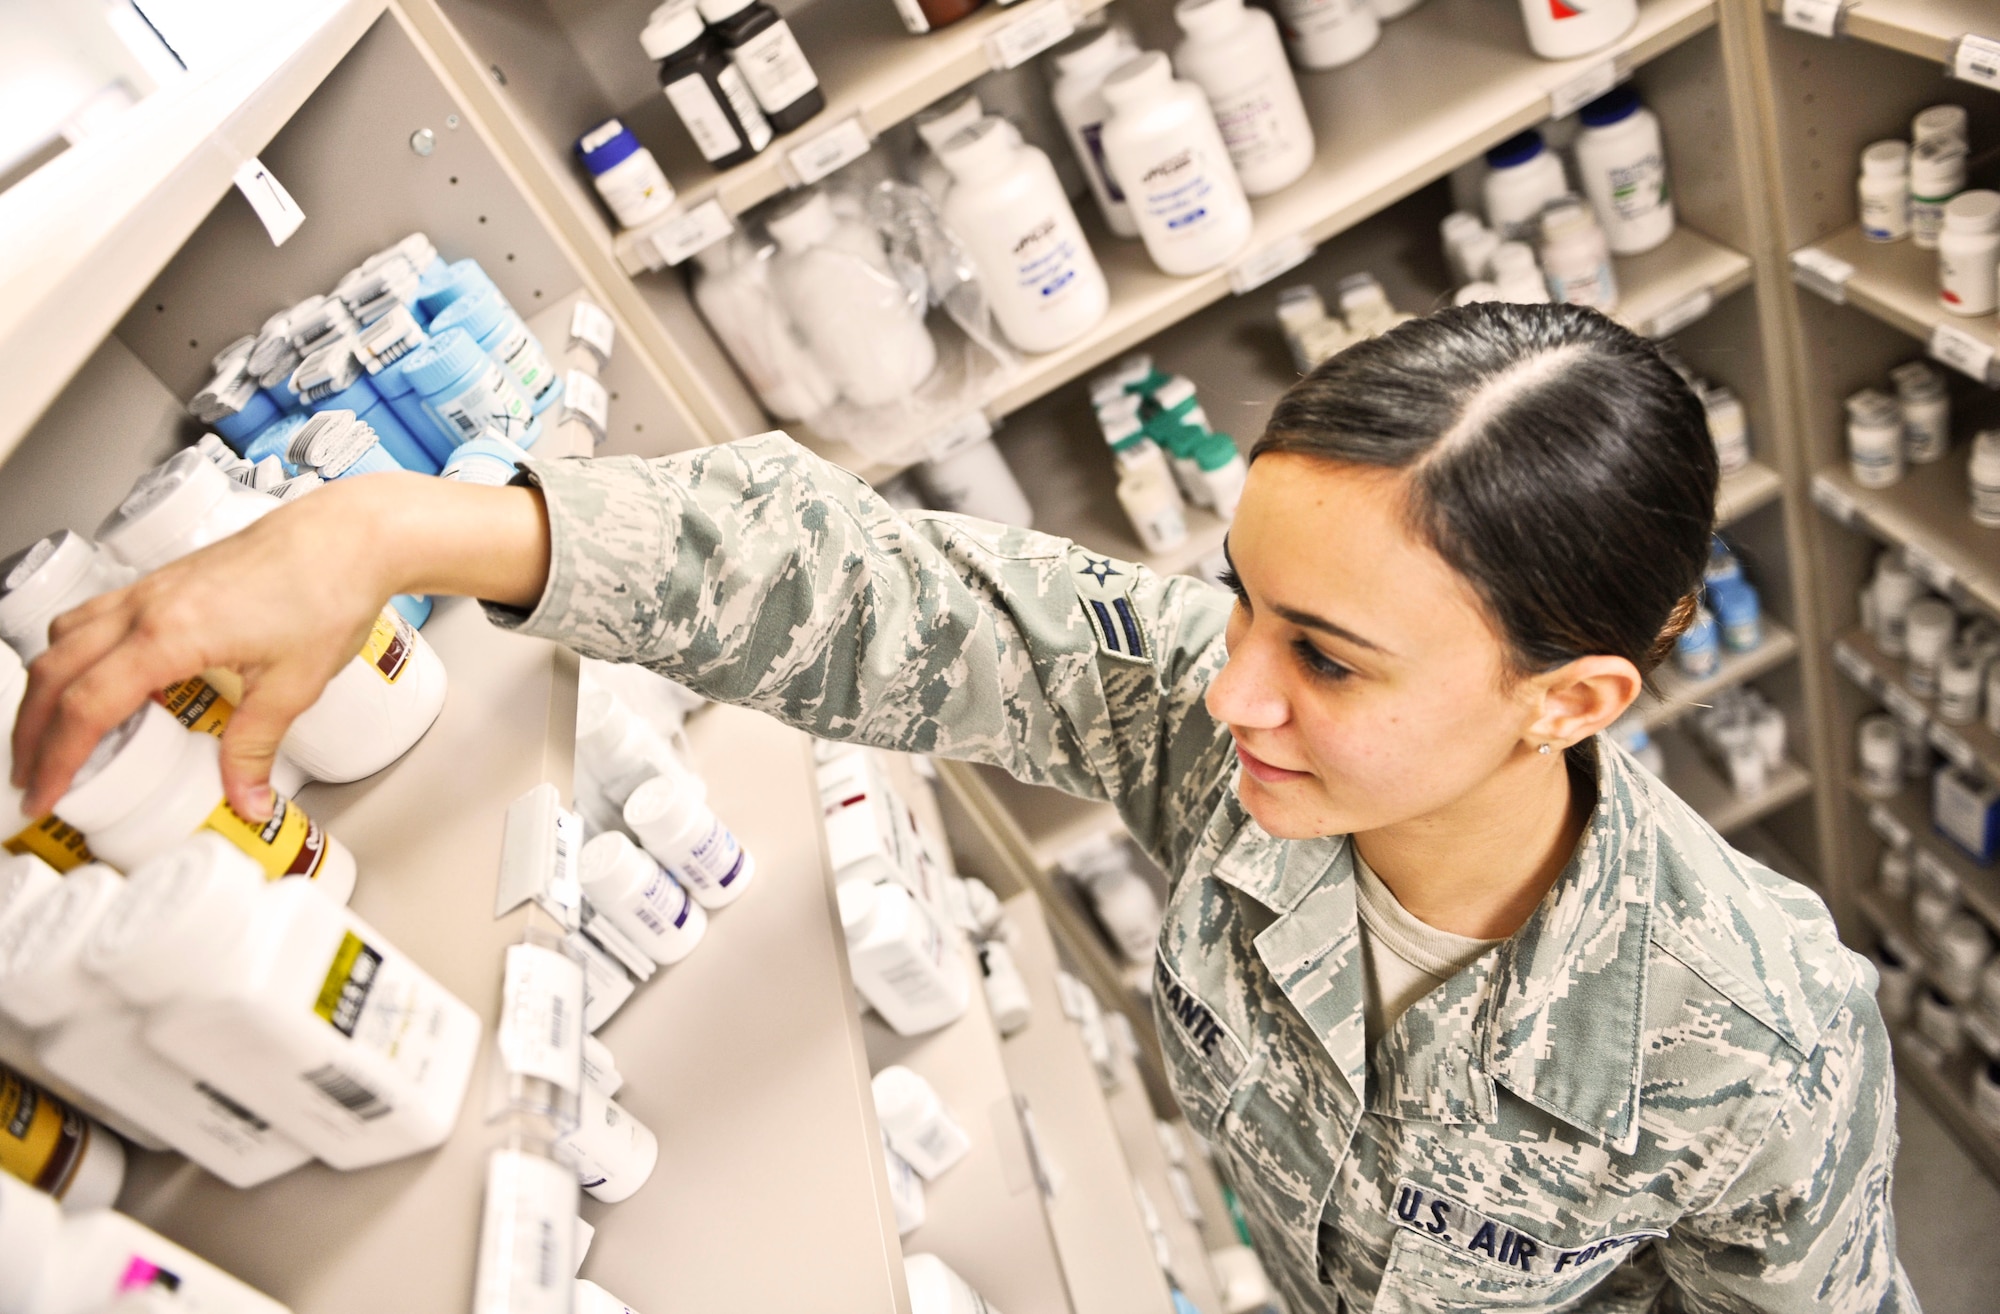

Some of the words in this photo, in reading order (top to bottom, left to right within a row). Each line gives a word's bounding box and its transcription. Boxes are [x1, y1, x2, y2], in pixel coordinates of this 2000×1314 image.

[166, 676, 202, 712] TABLETS
[1157, 952, 1225, 1056] RANTE
[1397, 1186, 1452, 1241] U.S.
[1468, 1221, 1538, 1271] AIR
